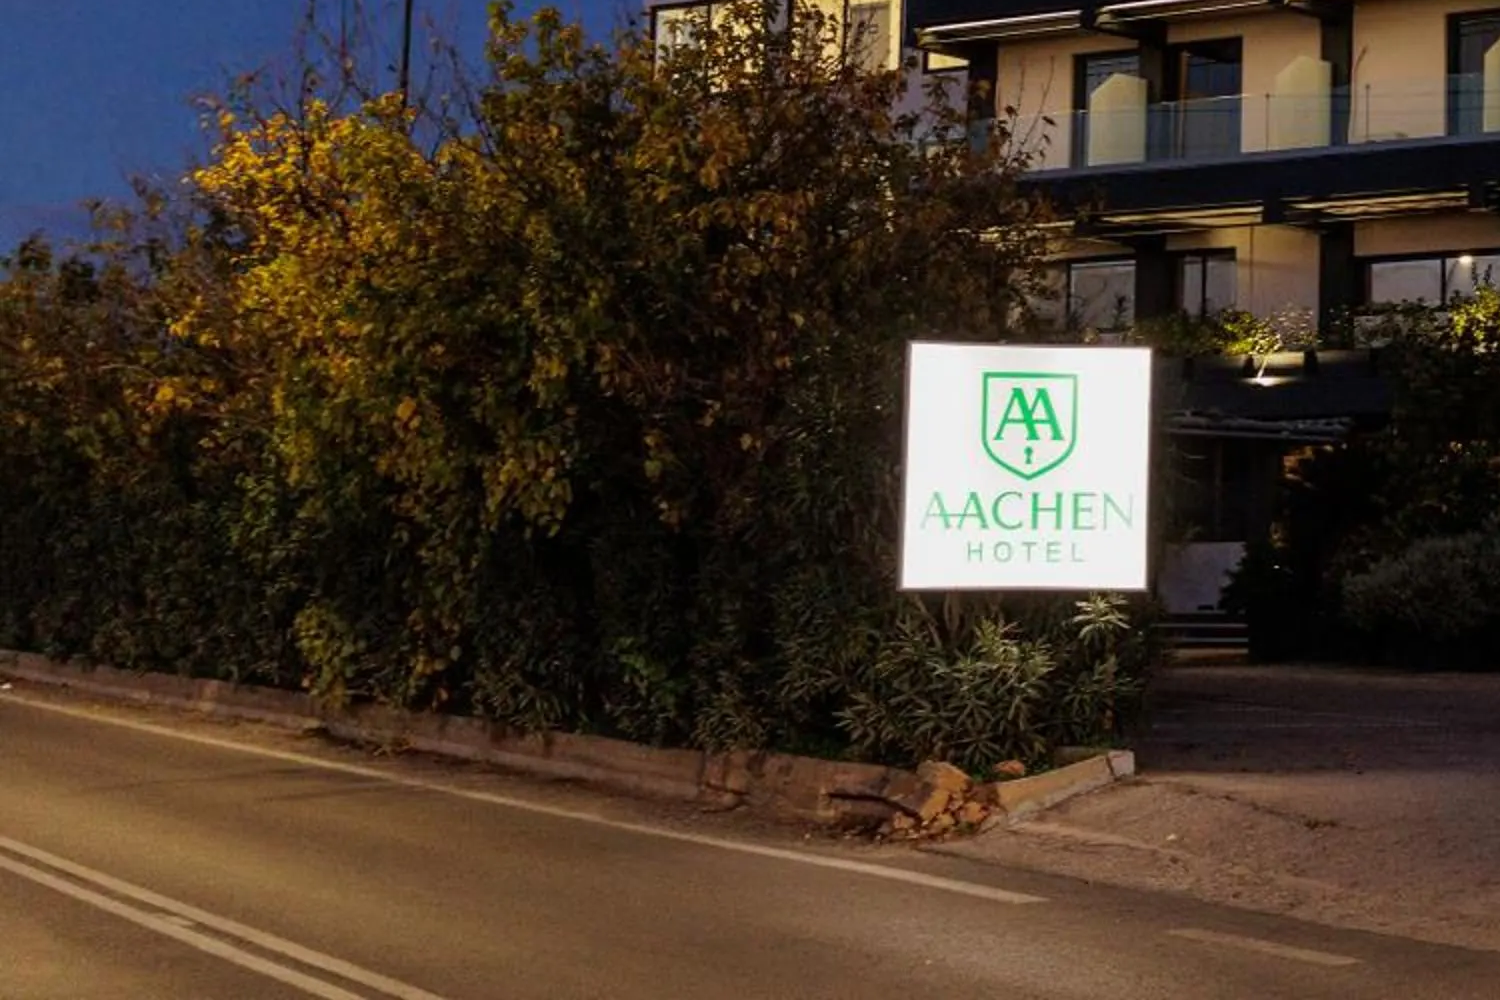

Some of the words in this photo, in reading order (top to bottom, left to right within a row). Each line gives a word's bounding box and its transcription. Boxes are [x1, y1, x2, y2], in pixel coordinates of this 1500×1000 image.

[993, 387, 1064, 441] AA
[920, 491, 1135, 531] AACHEN
[966, 541, 1086, 563] HOTEL
